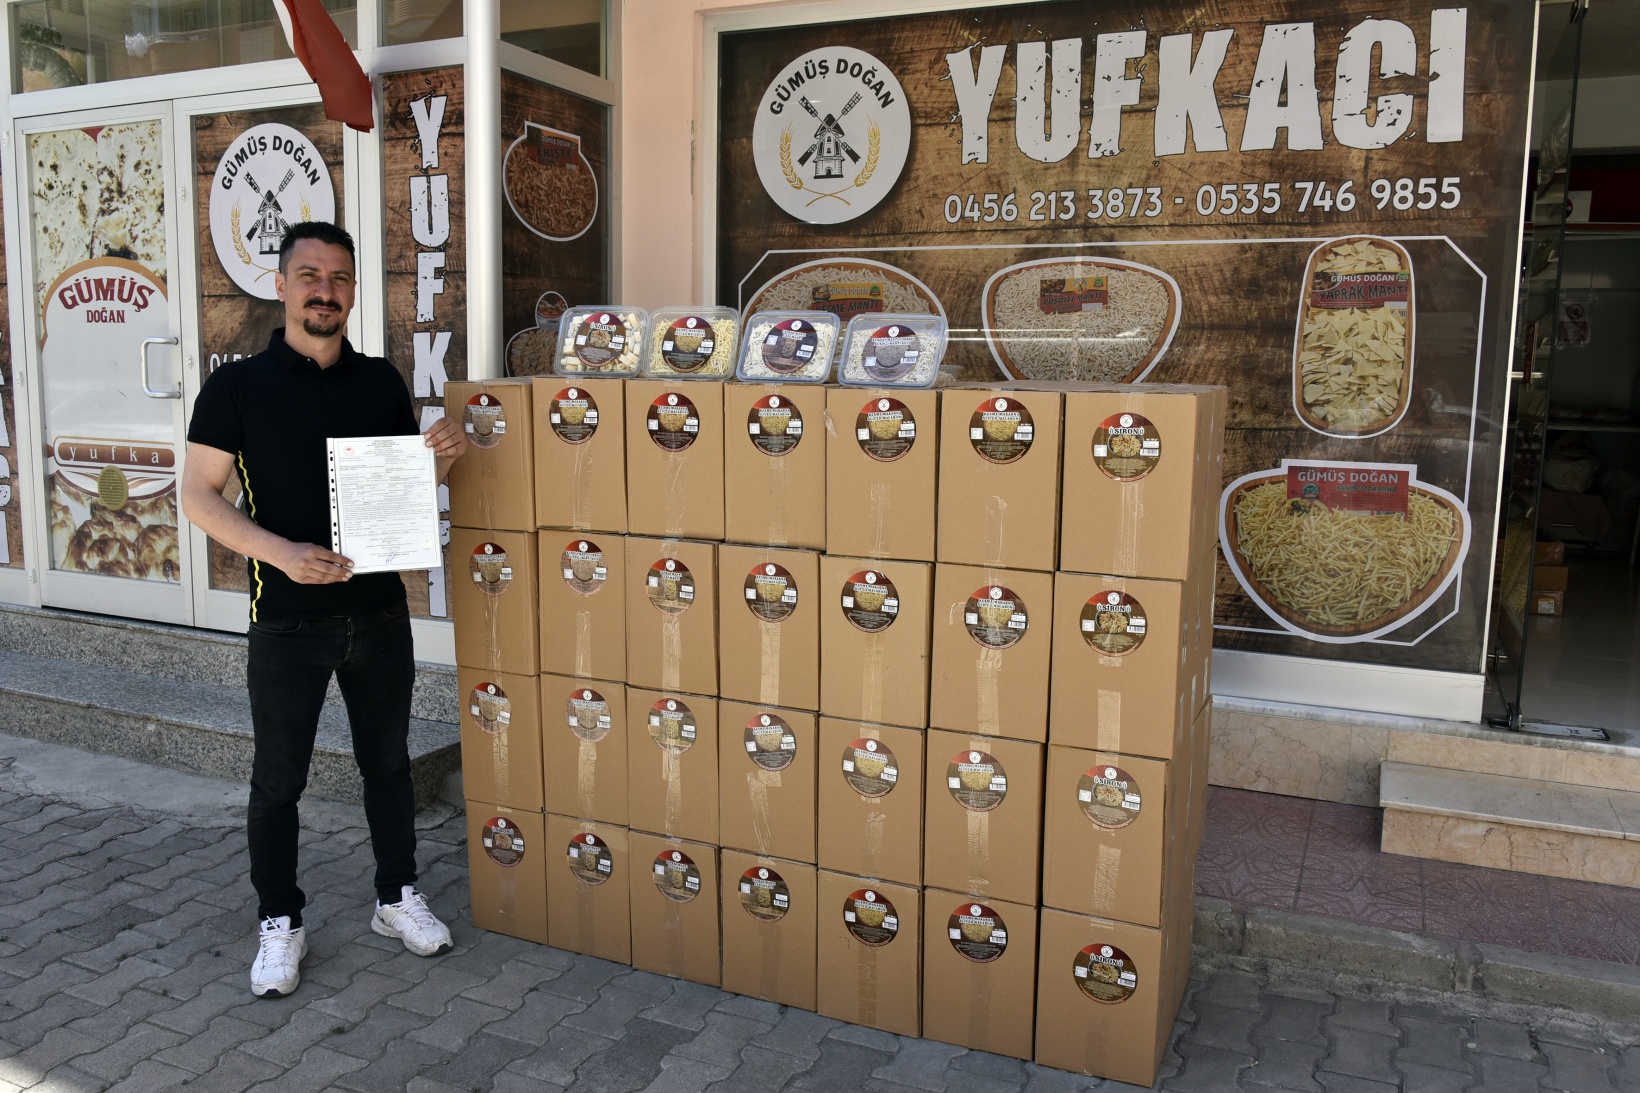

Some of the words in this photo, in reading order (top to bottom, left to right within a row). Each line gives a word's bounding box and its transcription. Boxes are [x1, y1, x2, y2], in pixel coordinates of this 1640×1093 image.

[769, 58, 830, 117] GÜMÜŞ
[836, 58, 895, 110] DOĞAN
[944, 8, 1467, 165] YUFKACI
[221, 135, 268, 190] GÜMÜŞ
[272, 135, 321, 187] DOĞAN
[944, 192, 1018, 224] 0456
[1029, 190, 1076, 222] 213
[1086, 187, 1163, 220] 3873
[1196, 182, 1281, 216] 0535
[1294, 180, 1356, 213] 746
[1370, 177, 1461, 211] 9855
[58, 275, 156, 313] GÜMÜŞ
[1319, 284, 1364, 301] YAPRAK
[1363, 272, 1394, 283] DOĞAN
[86, 306, 126, 324] DOĞAN
[408, 95, 453, 617] YUFKI
[1298, 470, 1346, 484] GÜMÜŞ
[1350, 471, 1399, 484] DOĞAN
